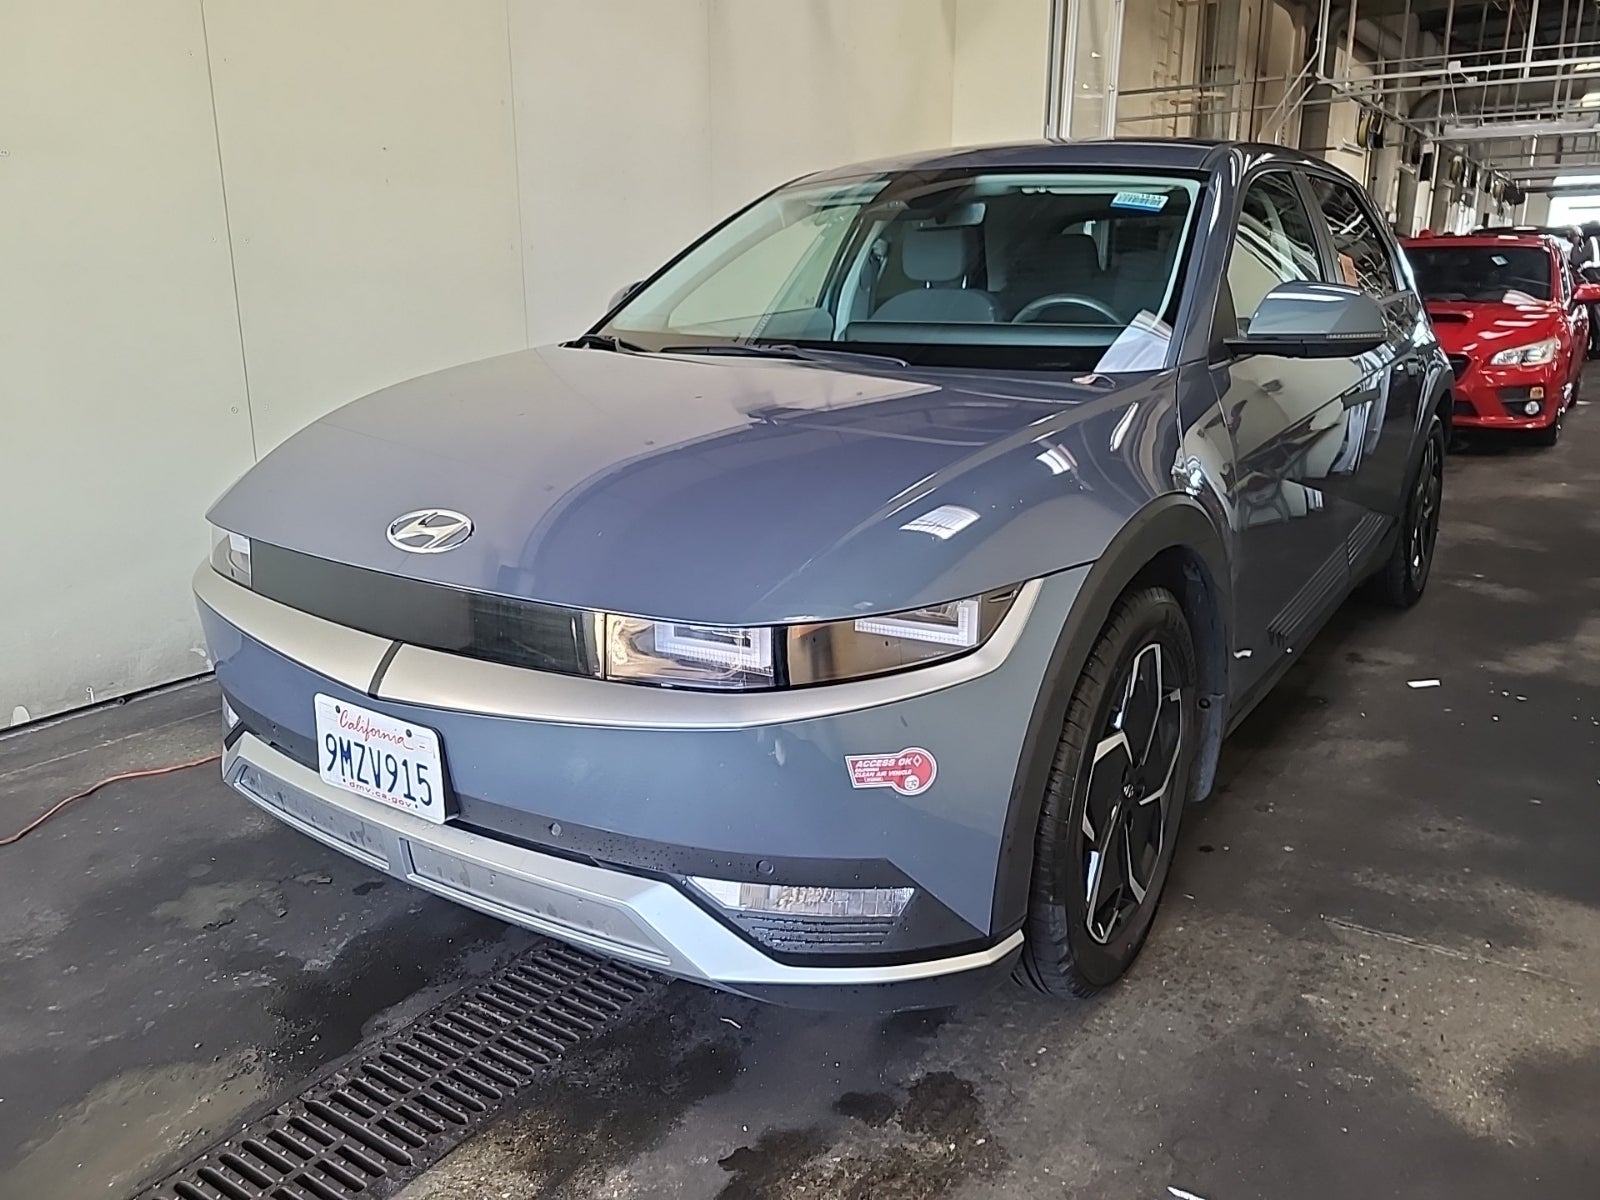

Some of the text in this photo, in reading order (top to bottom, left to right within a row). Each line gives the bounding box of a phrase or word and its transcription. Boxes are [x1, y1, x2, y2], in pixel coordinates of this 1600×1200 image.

[339, 709, 413, 750] California
[325, 733, 432, 806] 9MZV915
[855, 757, 913, 767] ACCESS OK
[349, 781, 412, 808] dmv.ca.gov
